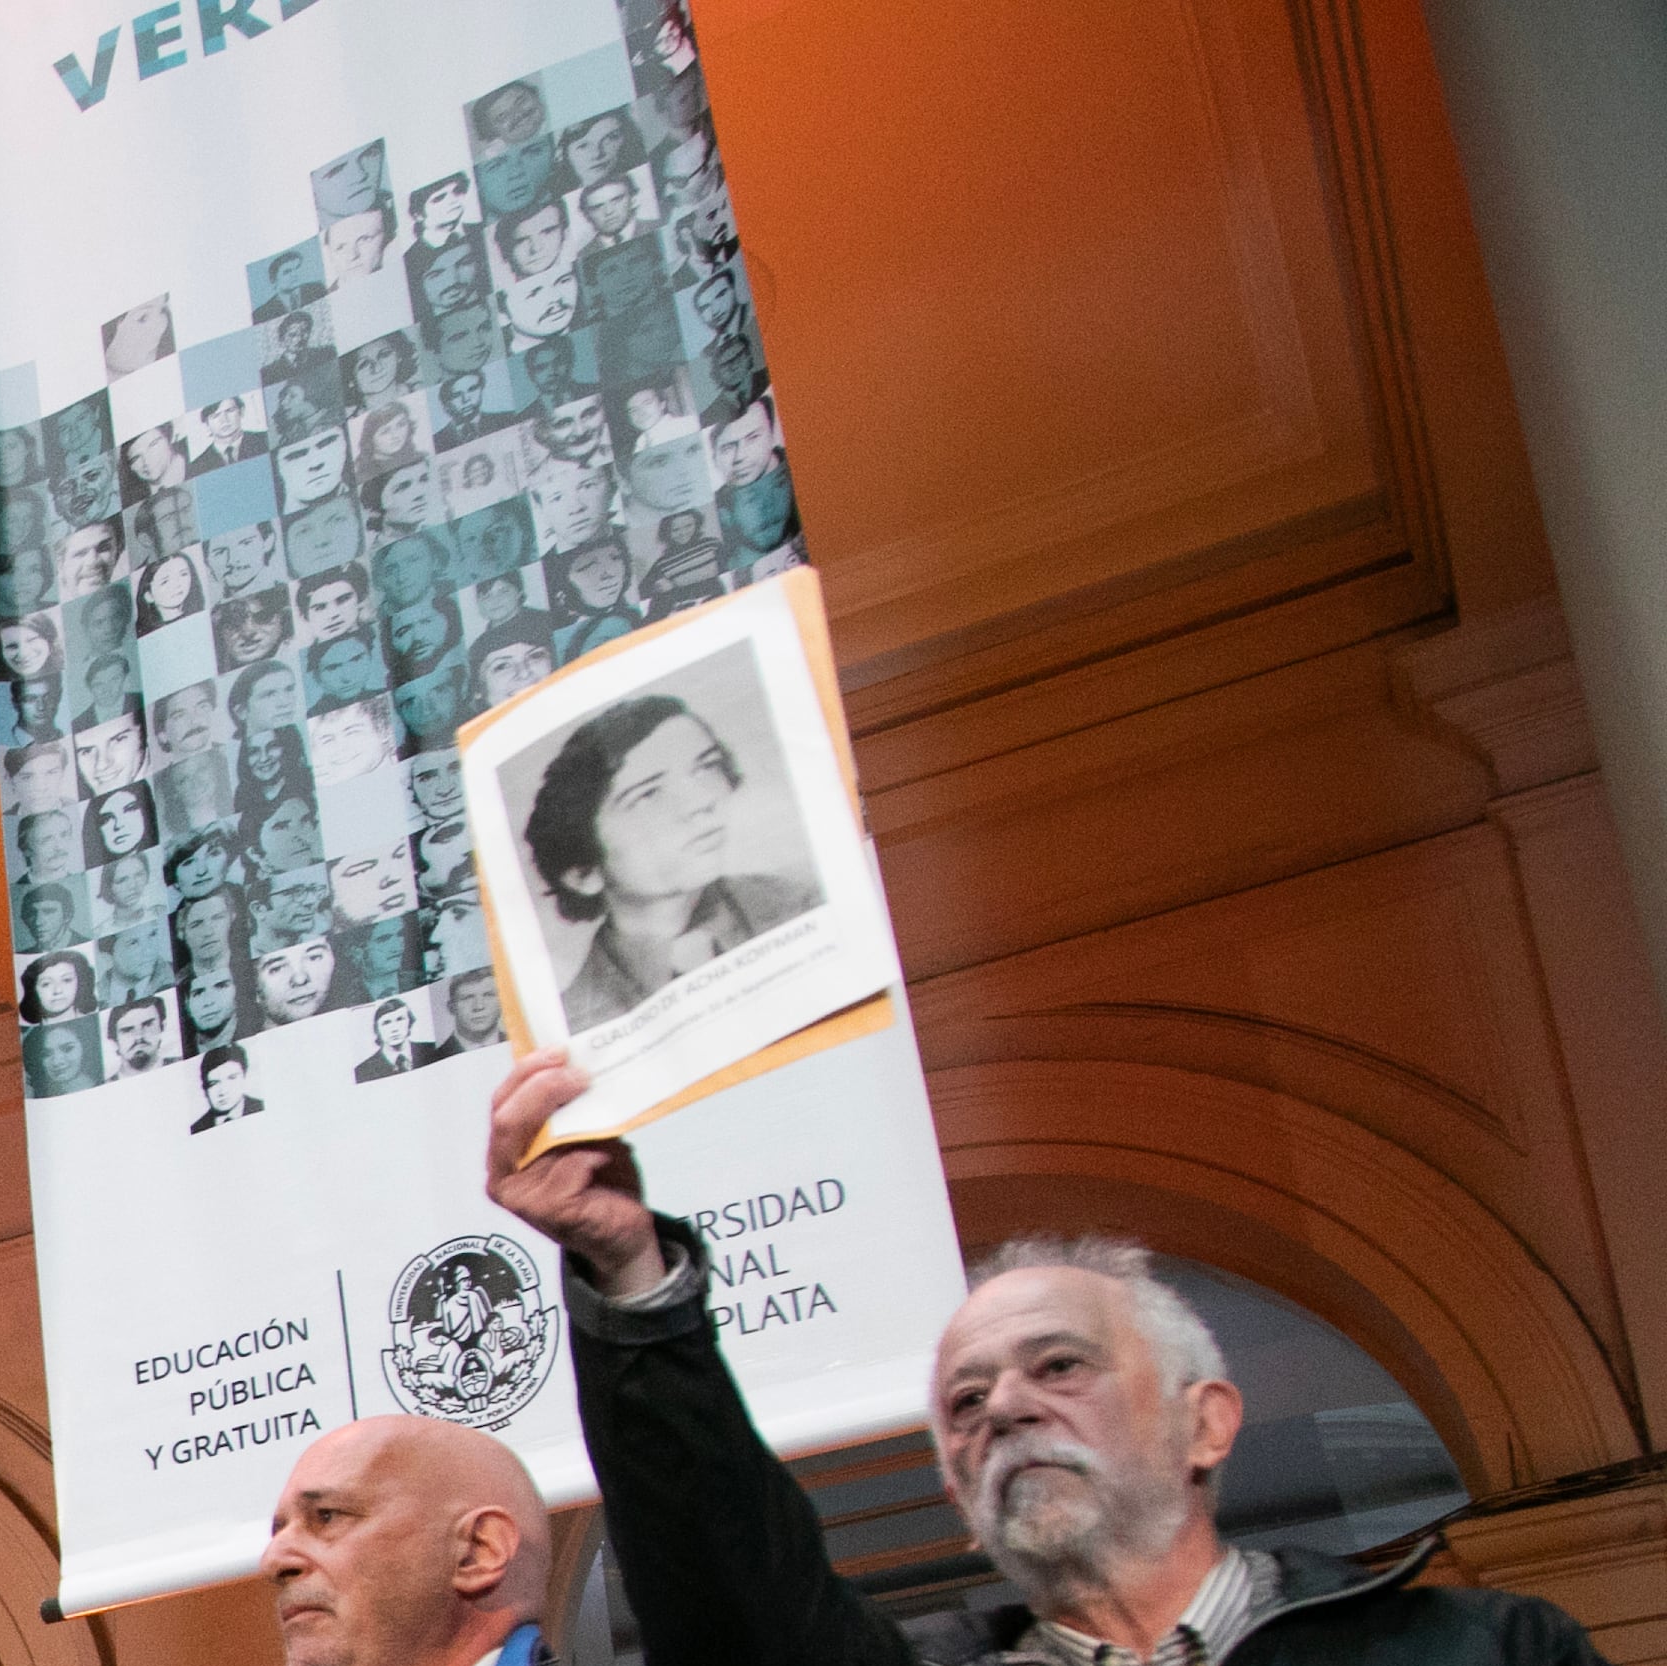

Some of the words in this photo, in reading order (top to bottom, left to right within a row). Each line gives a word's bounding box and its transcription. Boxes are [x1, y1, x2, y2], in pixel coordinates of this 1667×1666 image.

[53, 0, 318, 112] VER
[676, 1178, 846, 1240] RSIDAD
[394, 1261, 425, 1317] UNIVERSIDAD
[435, 1241, 480, 1260] NACIONAL
[709, 1244, 791, 1287] NAL
[135, 1317, 309, 1384] EDUCACIÓN
[190, 1363, 316, 1416] PÚBLICA
[145, 1445, 163, 1470] Y
[172, 1408, 322, 1464] GRATUITA
